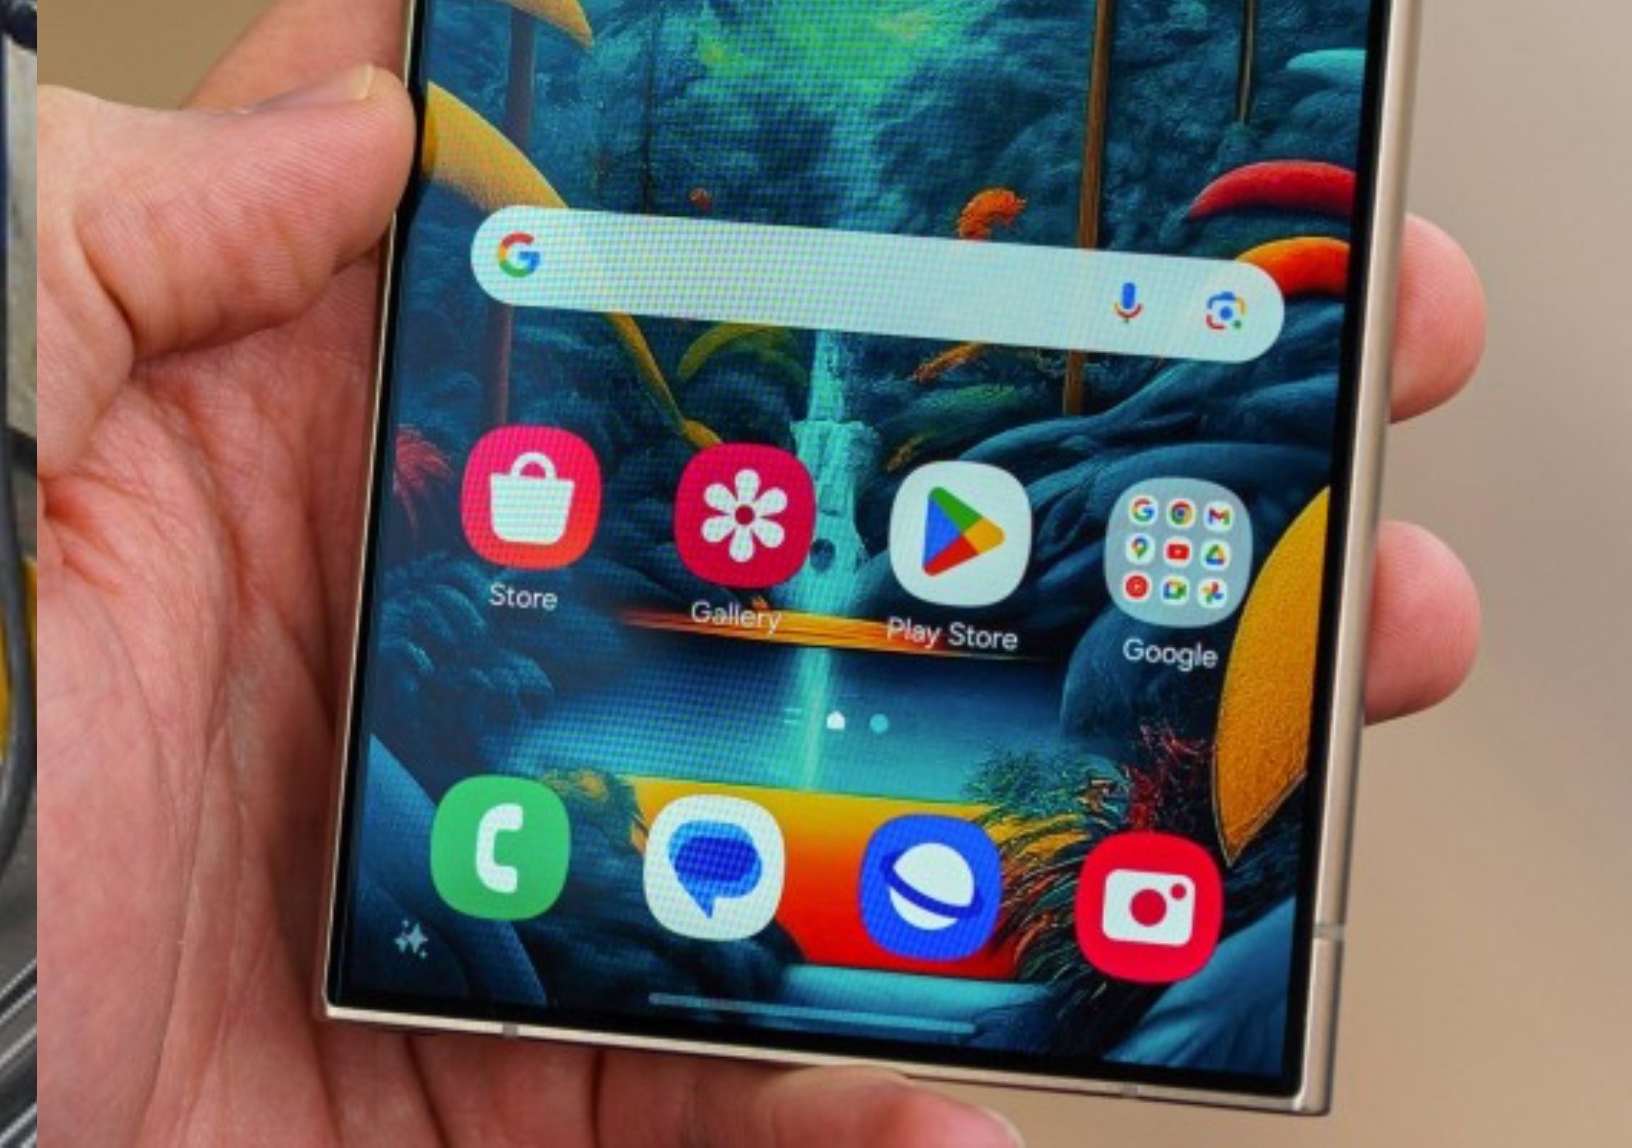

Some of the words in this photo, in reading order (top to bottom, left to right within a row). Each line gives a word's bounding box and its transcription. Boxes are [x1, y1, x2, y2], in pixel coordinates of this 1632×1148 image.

[488, 582, 558, 611] Store
[691, 601, 781, 633] Gallery
[886, 615, 942, 650] Play
[947, 621, 1018, 651] Store
[1123, 638, 1218, 672] Google
